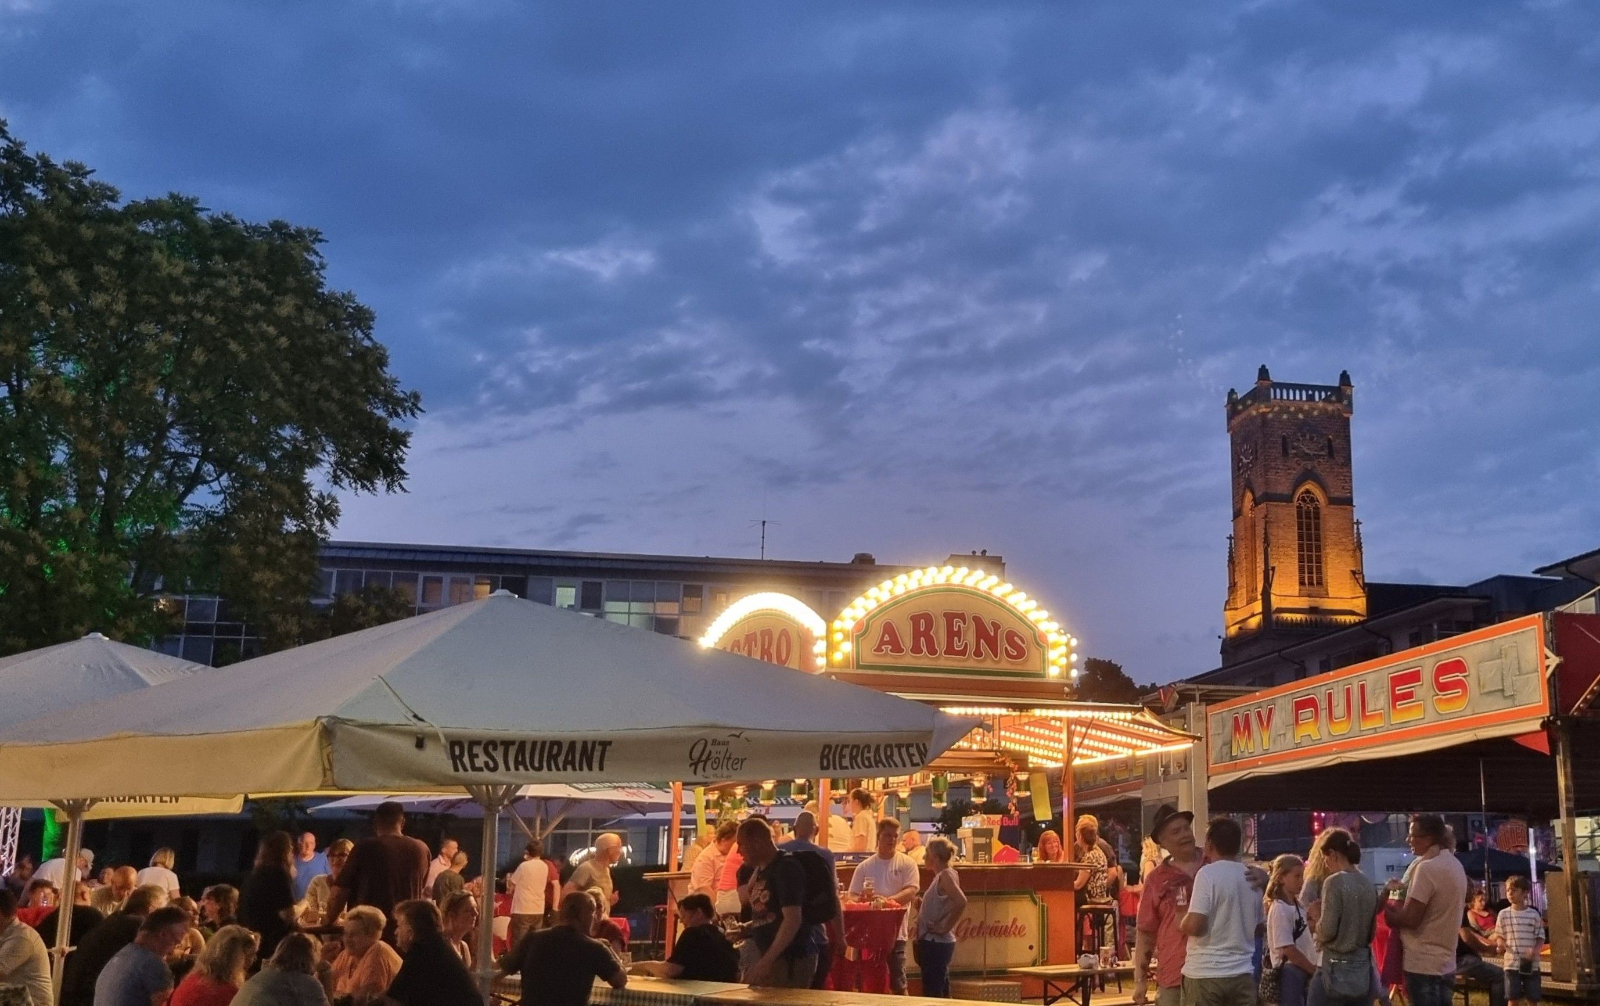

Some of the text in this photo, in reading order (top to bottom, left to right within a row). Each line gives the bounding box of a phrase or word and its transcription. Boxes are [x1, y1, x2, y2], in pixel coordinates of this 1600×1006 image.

[872, 611, 1028, 661] ARENS
[1231, 656, 1471, 756] MY RULES
[449, 740, 613, 773] RESTAURANT
[820, 743, 928, 771] BIERGARTEN
[1002, 816, 1019, 826] Bull
[955, 917, 1027, 941] Getränke
